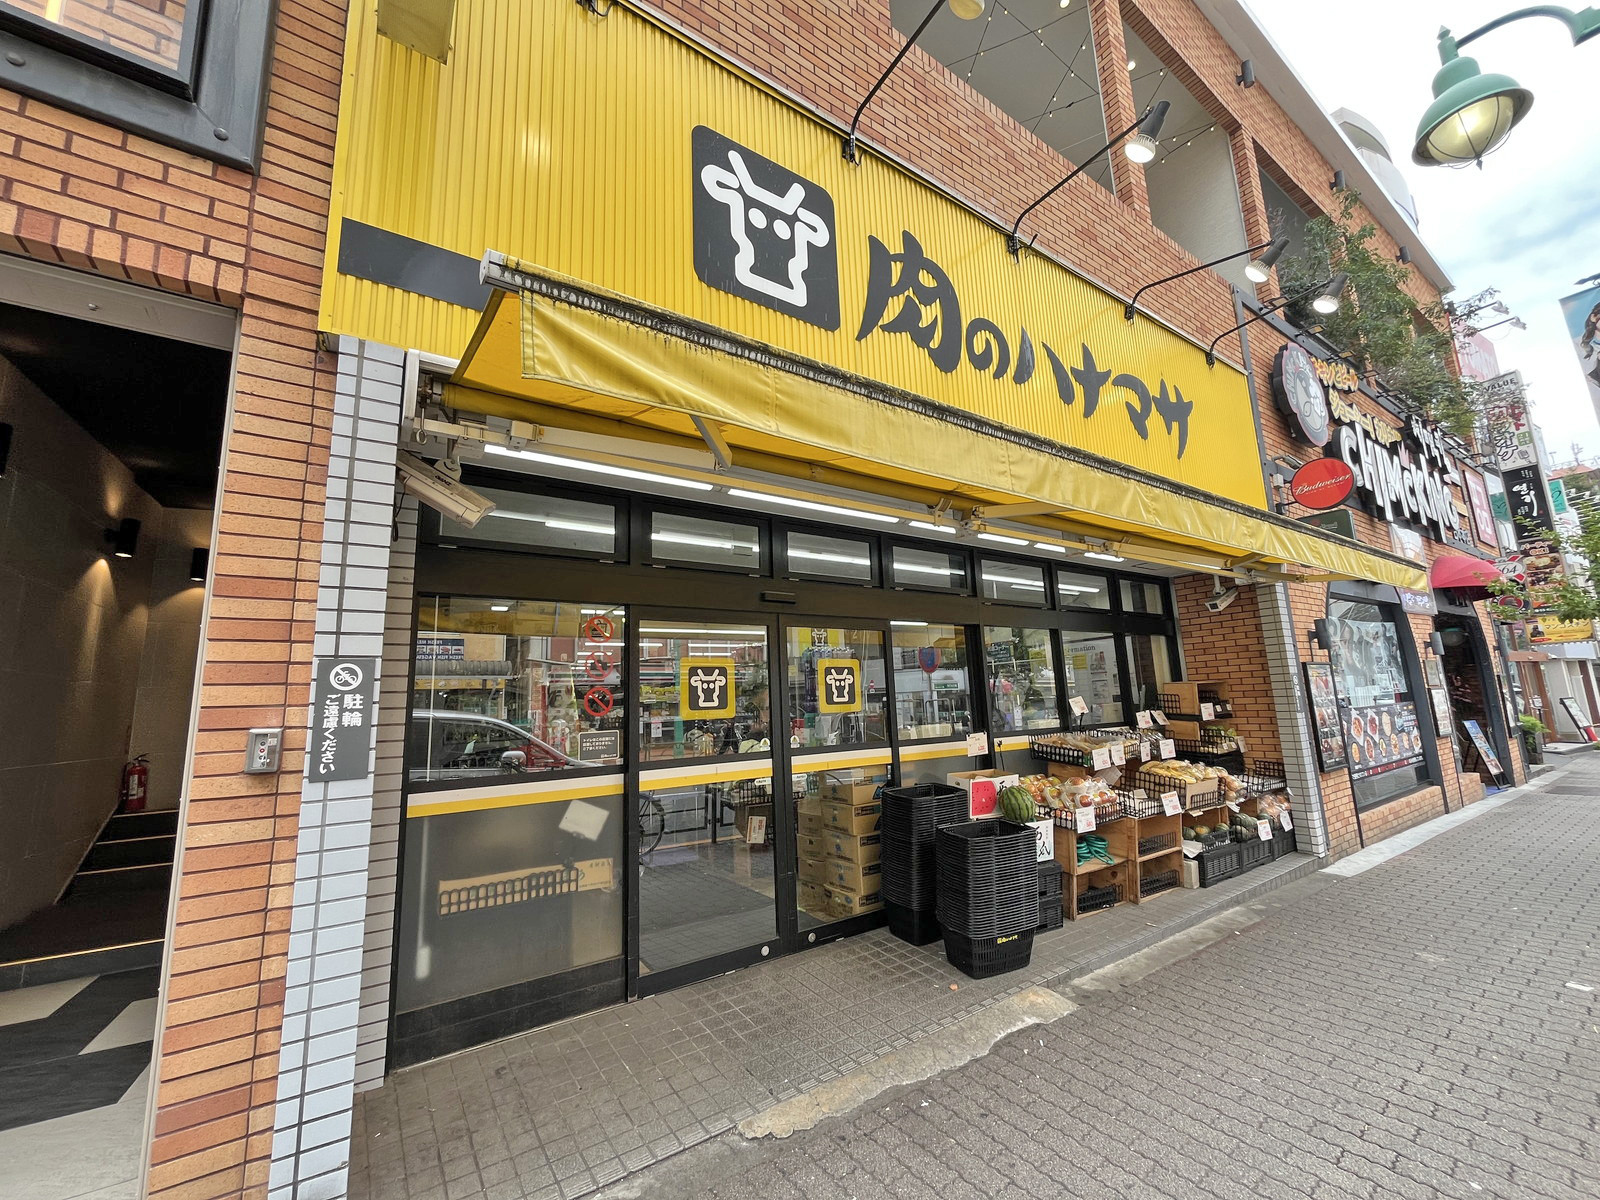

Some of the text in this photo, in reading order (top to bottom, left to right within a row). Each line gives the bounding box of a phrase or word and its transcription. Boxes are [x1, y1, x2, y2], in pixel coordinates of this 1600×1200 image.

[855, 229, 1194, 460] 肉のハナマサ
[1484, 377, 1516, 393] VALUE
[1293, 473, 1352, 496] Budweiser
[341, 693, 364, 727] 駐輪
[319, 693, 342, 775] ご遠慮ください
